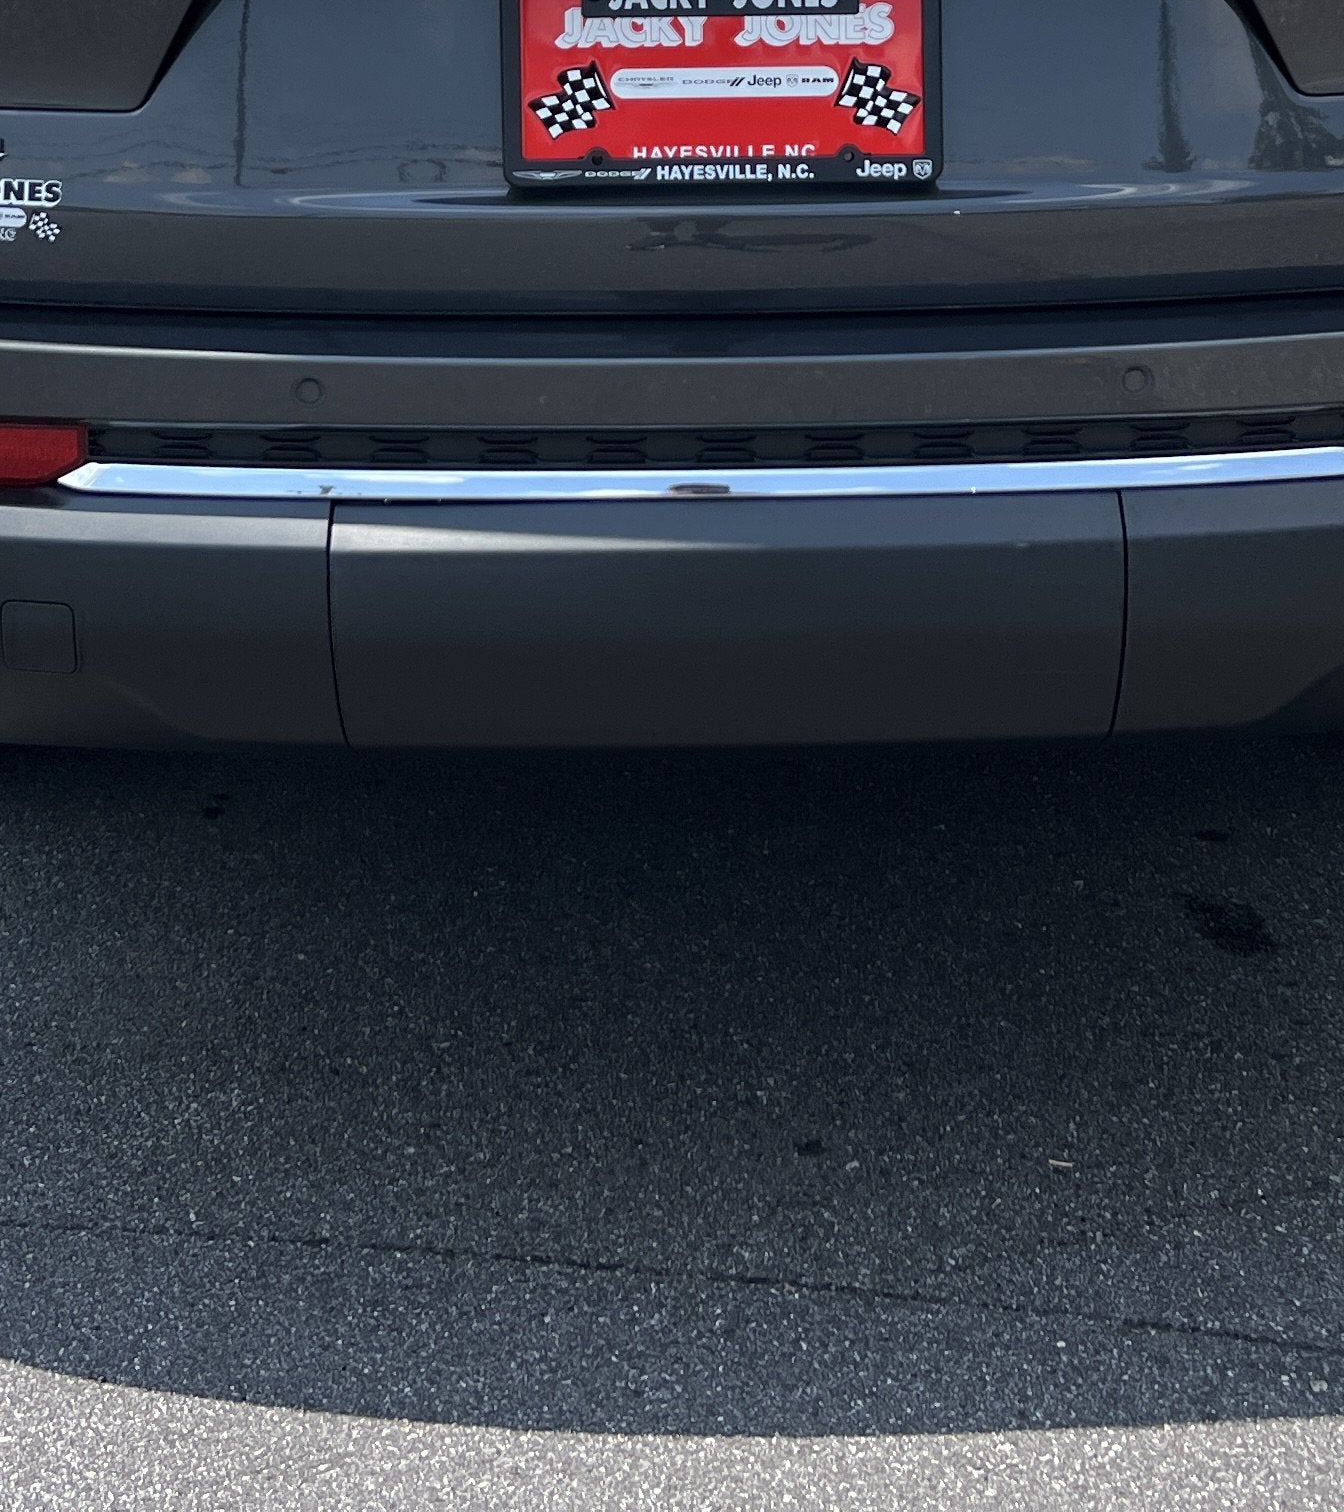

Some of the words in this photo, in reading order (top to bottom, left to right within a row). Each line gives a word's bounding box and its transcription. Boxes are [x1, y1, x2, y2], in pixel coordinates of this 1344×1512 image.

[555, 6, 707, 49] JACKY
[734, 1, 895, 47] JONES
[747, 74, 782, 88] Jeep
[656, 163, 773, 182] HAYESVILLE,
[777, 163, 815, 180] N.C.
[856, 159, 907, 180] Jeep
